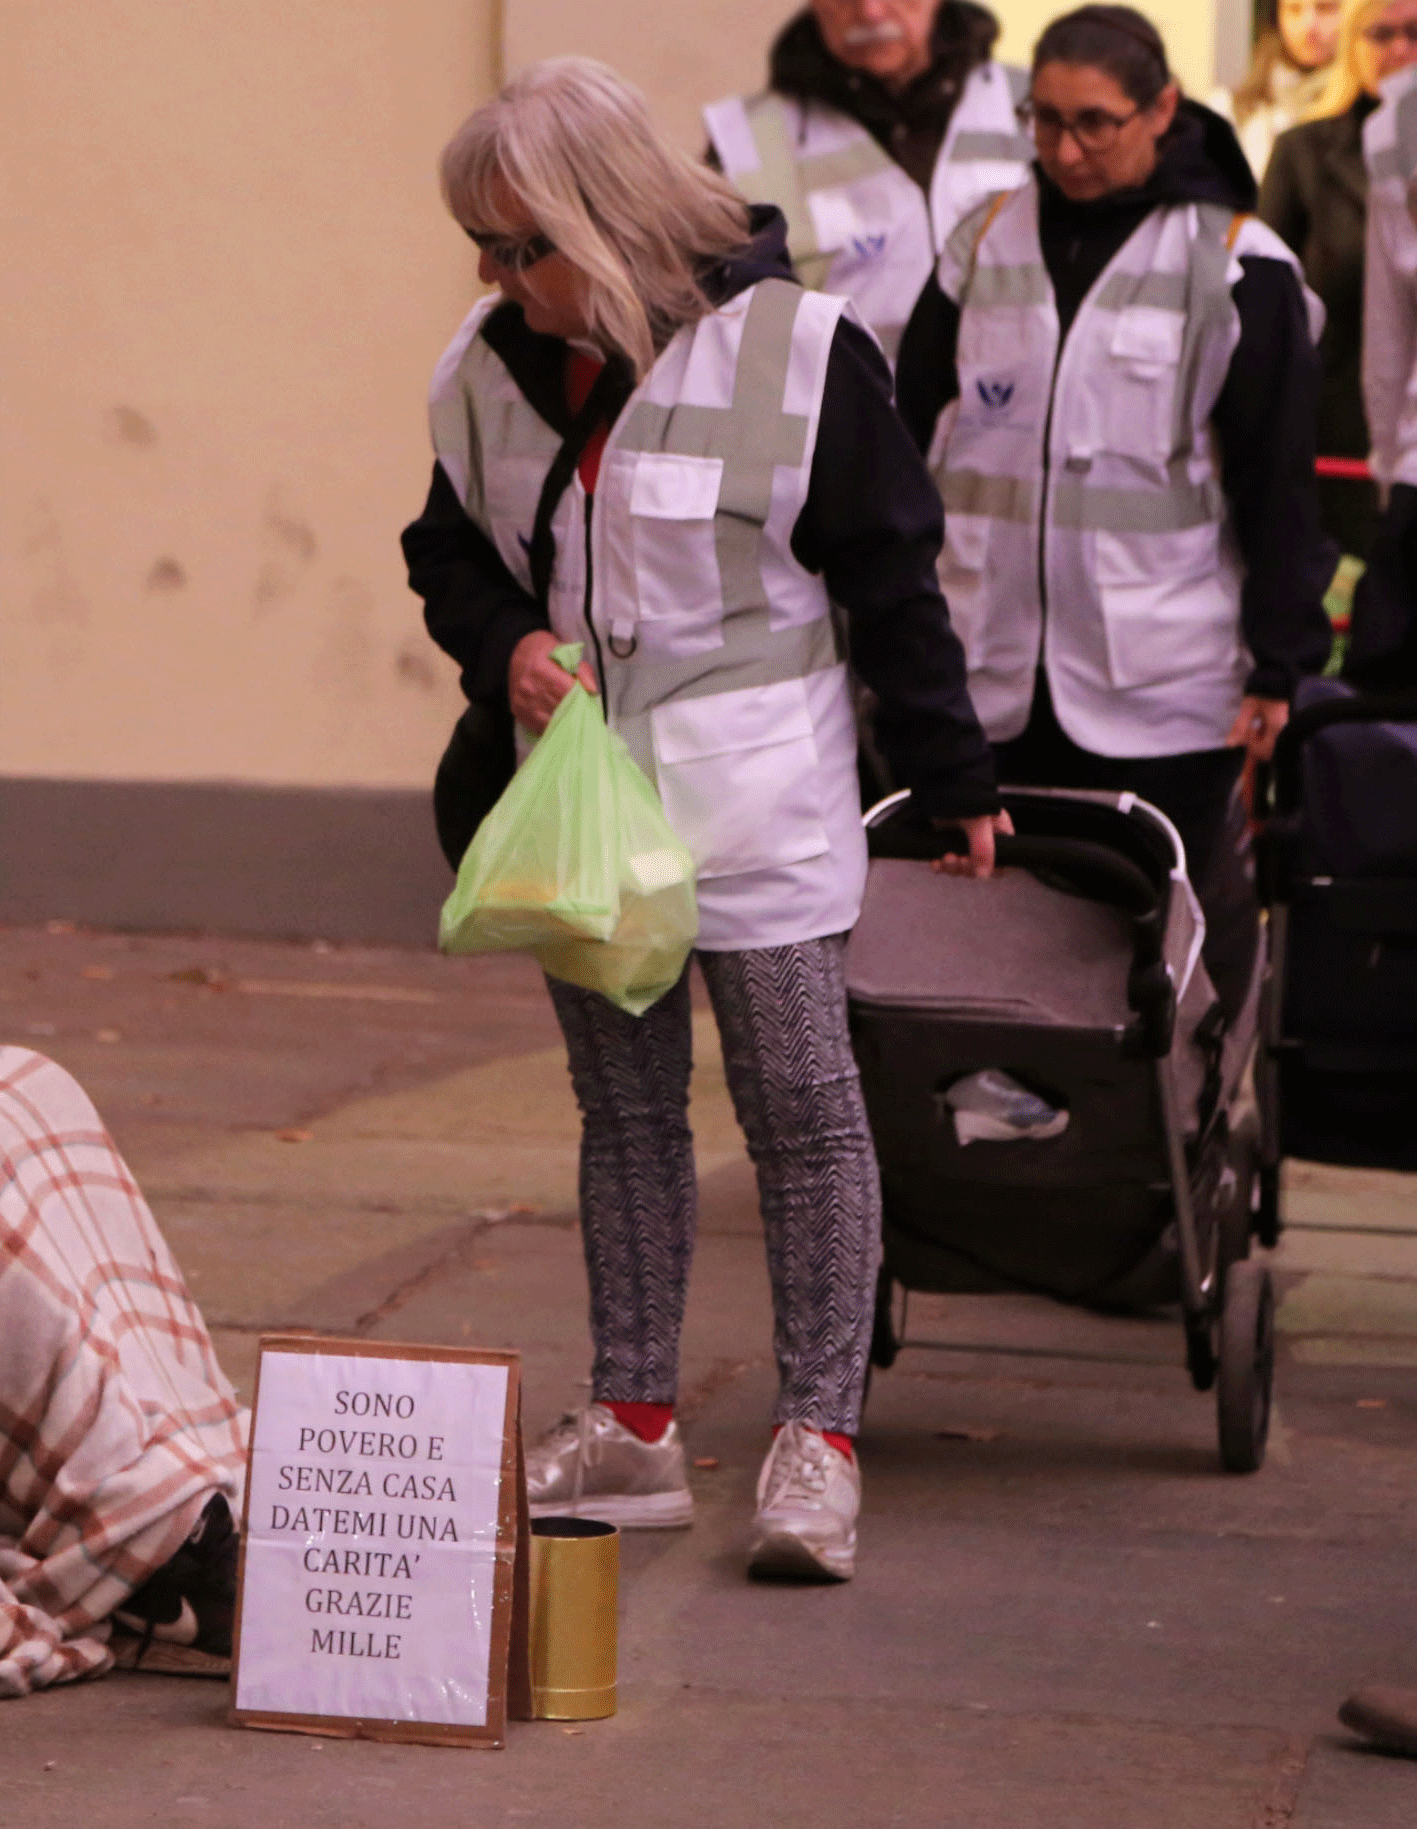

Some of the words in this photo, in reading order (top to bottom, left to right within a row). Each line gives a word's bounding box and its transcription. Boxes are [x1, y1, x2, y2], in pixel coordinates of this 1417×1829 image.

[335, 1390, 414, 1419] SONO
[299, 1428, 417, 1458] POVERO
[428, 1436, 444, 1460] E
[278, 1466, 372, 1495] SENZA
[383, 1473, 456, 1502] CASA
[271, 1505, 386, 1537] DATEMI
[398, 1514, 458, 1542] UNA
[304, 1548, 420, 1579] CARITA'
[306, 1588, 412, 1619] GRAZIE
[311, 1629, 401, 1659] MILLE
